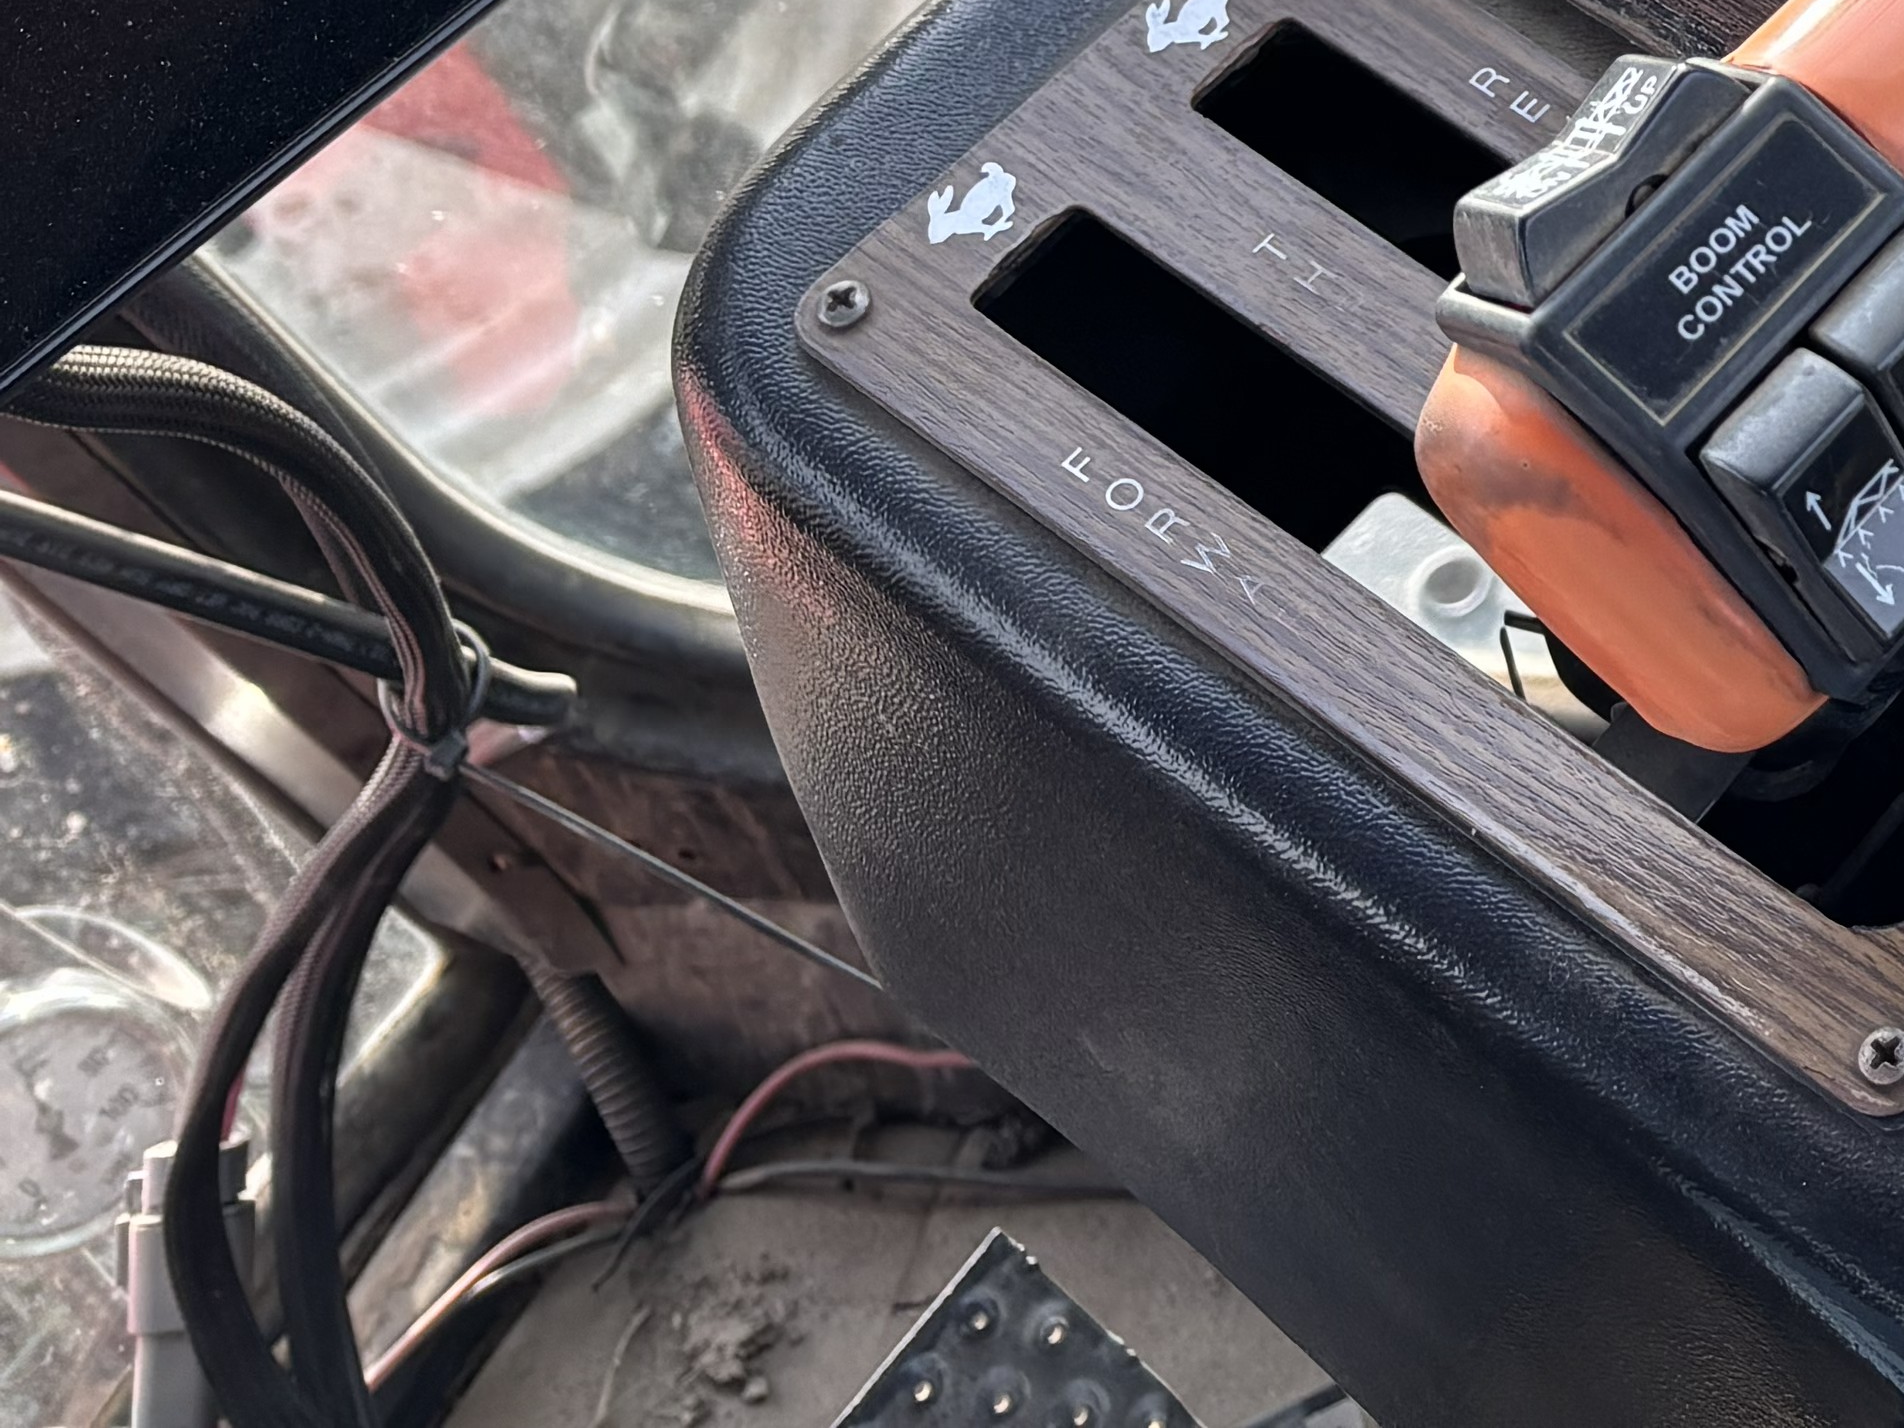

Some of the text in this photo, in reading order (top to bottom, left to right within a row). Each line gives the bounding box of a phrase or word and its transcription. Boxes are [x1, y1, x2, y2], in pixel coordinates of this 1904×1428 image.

[1625, 75, 1659, 115] UP
[1668, 204, 1760, 295] BOOM
[1678, 215, 1812, 341] CONTROL
